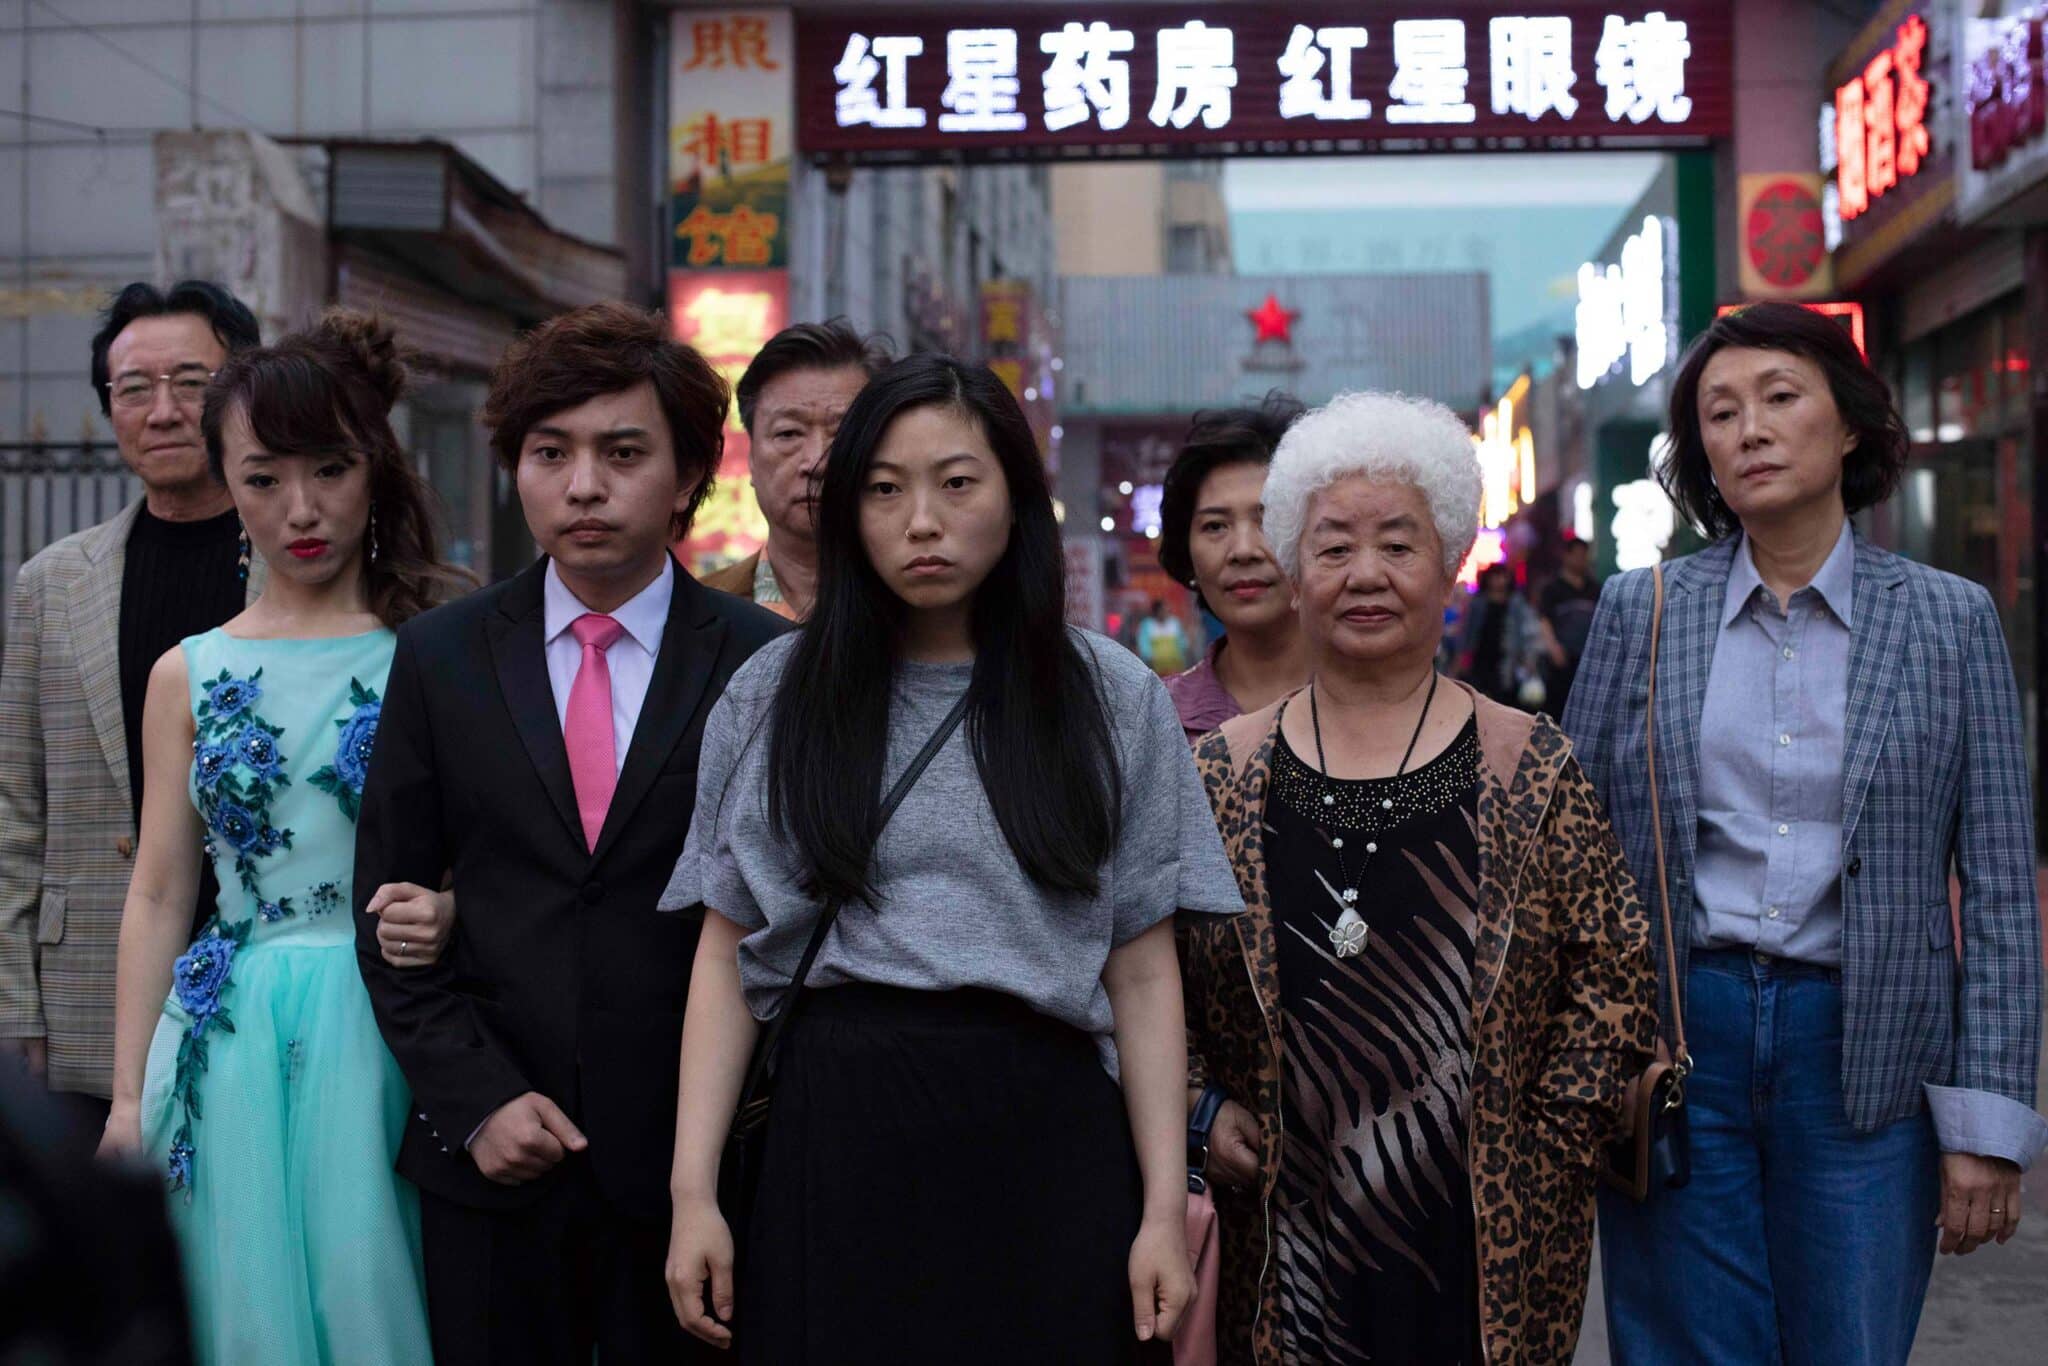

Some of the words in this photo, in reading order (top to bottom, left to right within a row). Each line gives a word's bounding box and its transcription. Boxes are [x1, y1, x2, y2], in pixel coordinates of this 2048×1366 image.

[676, 15, 780, 264] 照相馆
[833, 20, 1238, 132] 红星药房
[1277, 11, 1693, 123] 红星眼镜
